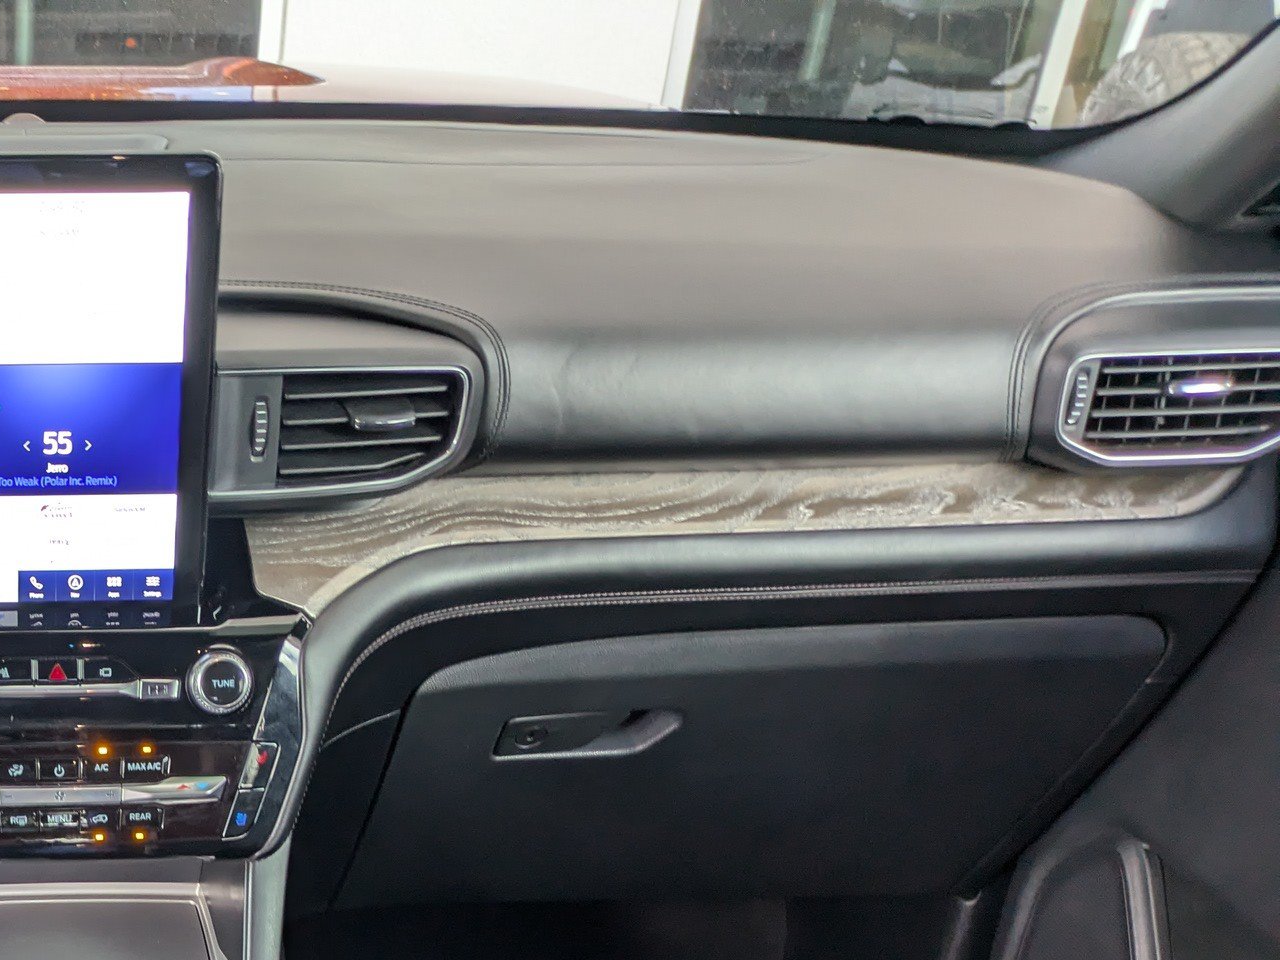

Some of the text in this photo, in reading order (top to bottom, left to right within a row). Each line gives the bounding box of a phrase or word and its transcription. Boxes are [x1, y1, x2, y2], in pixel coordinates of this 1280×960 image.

[42, 430, 73, 455] 55
[13, 476, 39, 487] Weak
[40, 475, 67, 488] (Polar
[68, 475, 84, 486] Inc.
[85, 475, 118, 487] Remix)
[211, 679, 236, 689] TUNE
[94, 763, 109, 773] A/C
[127, 761, 162, 772] MAX A/C
[47, 813, 73, 823] MENU
[129, 812, 152, 822] REAR
